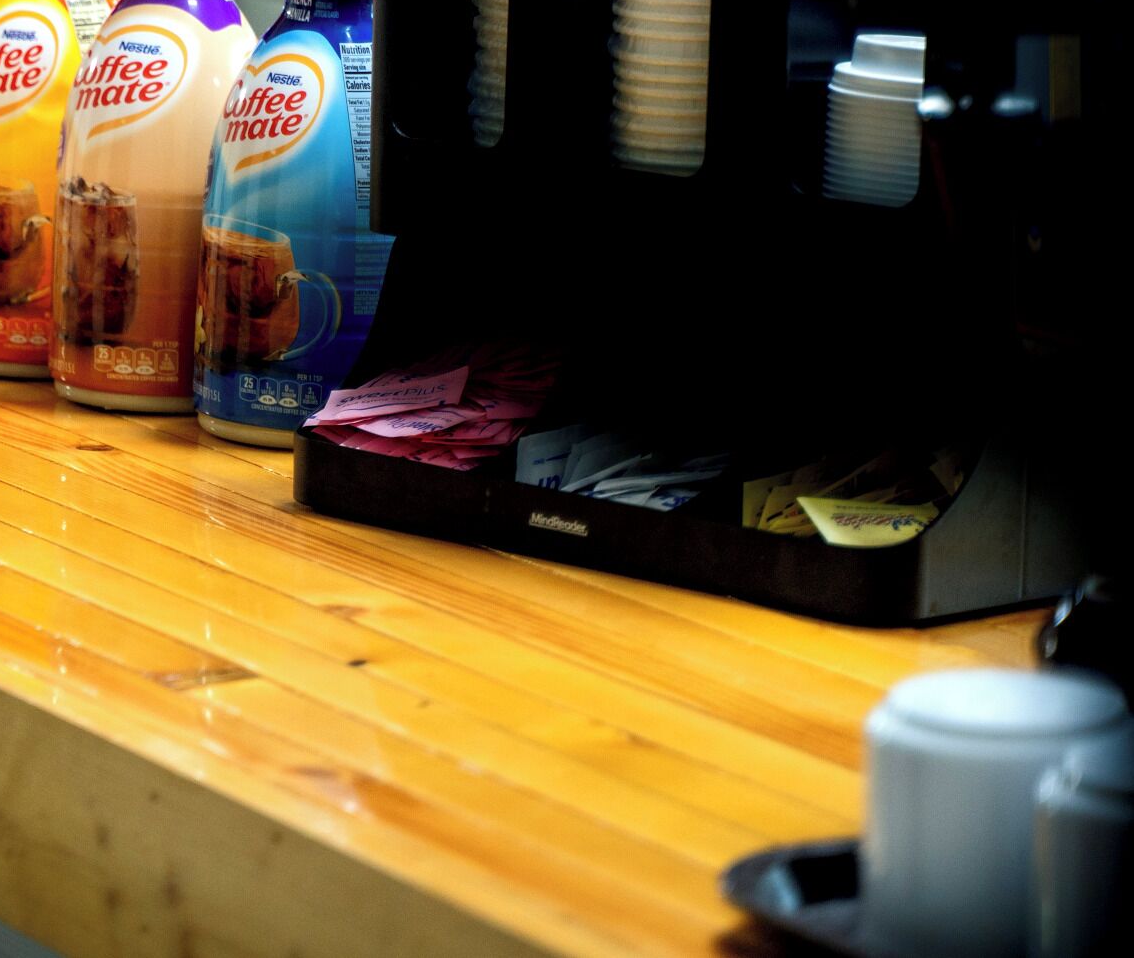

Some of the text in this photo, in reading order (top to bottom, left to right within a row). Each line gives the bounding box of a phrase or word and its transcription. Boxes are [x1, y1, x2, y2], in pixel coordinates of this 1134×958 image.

[118, 40, 161, 56] Nestlé
[341, 44, 371, 55] Nutrition
[344, 64, 359, 72] Serving
[266, 72, 302, 87] Nestlé
[346, 80, 371, 90] Calories
[75, 79, 164, 111] mate
[223, 78, 307, 119] Coffee
[225, 112, 304, 143] mate
[243, 376, 254, 389] 25
[296, 373, 307, 381] PER
